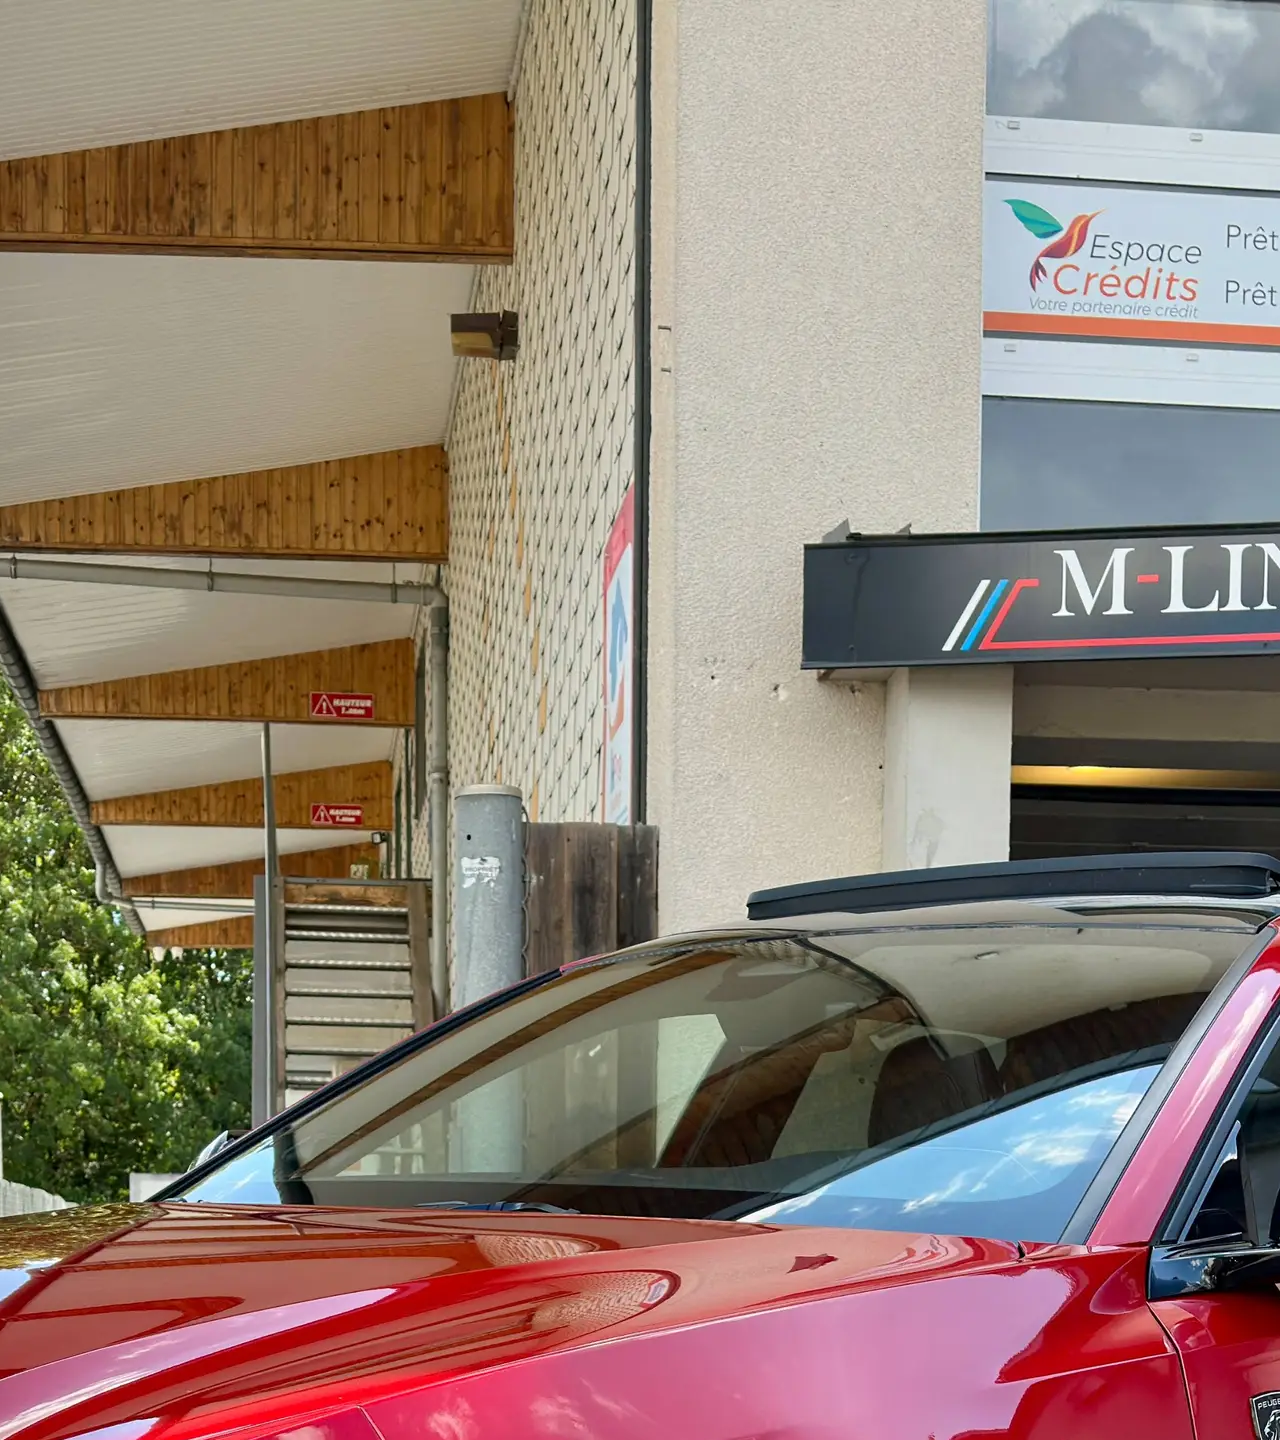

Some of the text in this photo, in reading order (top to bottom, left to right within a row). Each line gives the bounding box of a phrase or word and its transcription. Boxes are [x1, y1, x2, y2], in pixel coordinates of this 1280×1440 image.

[1089, 234, 1202, 266] Espace
[1225, 224, 1278, 252] Prêt
[1053, 263, 1199, 302] Crédits
[1225, 280, 1277, 307] Prêt
[1029, 297, 1199, 320] Votre partenaire crédit
